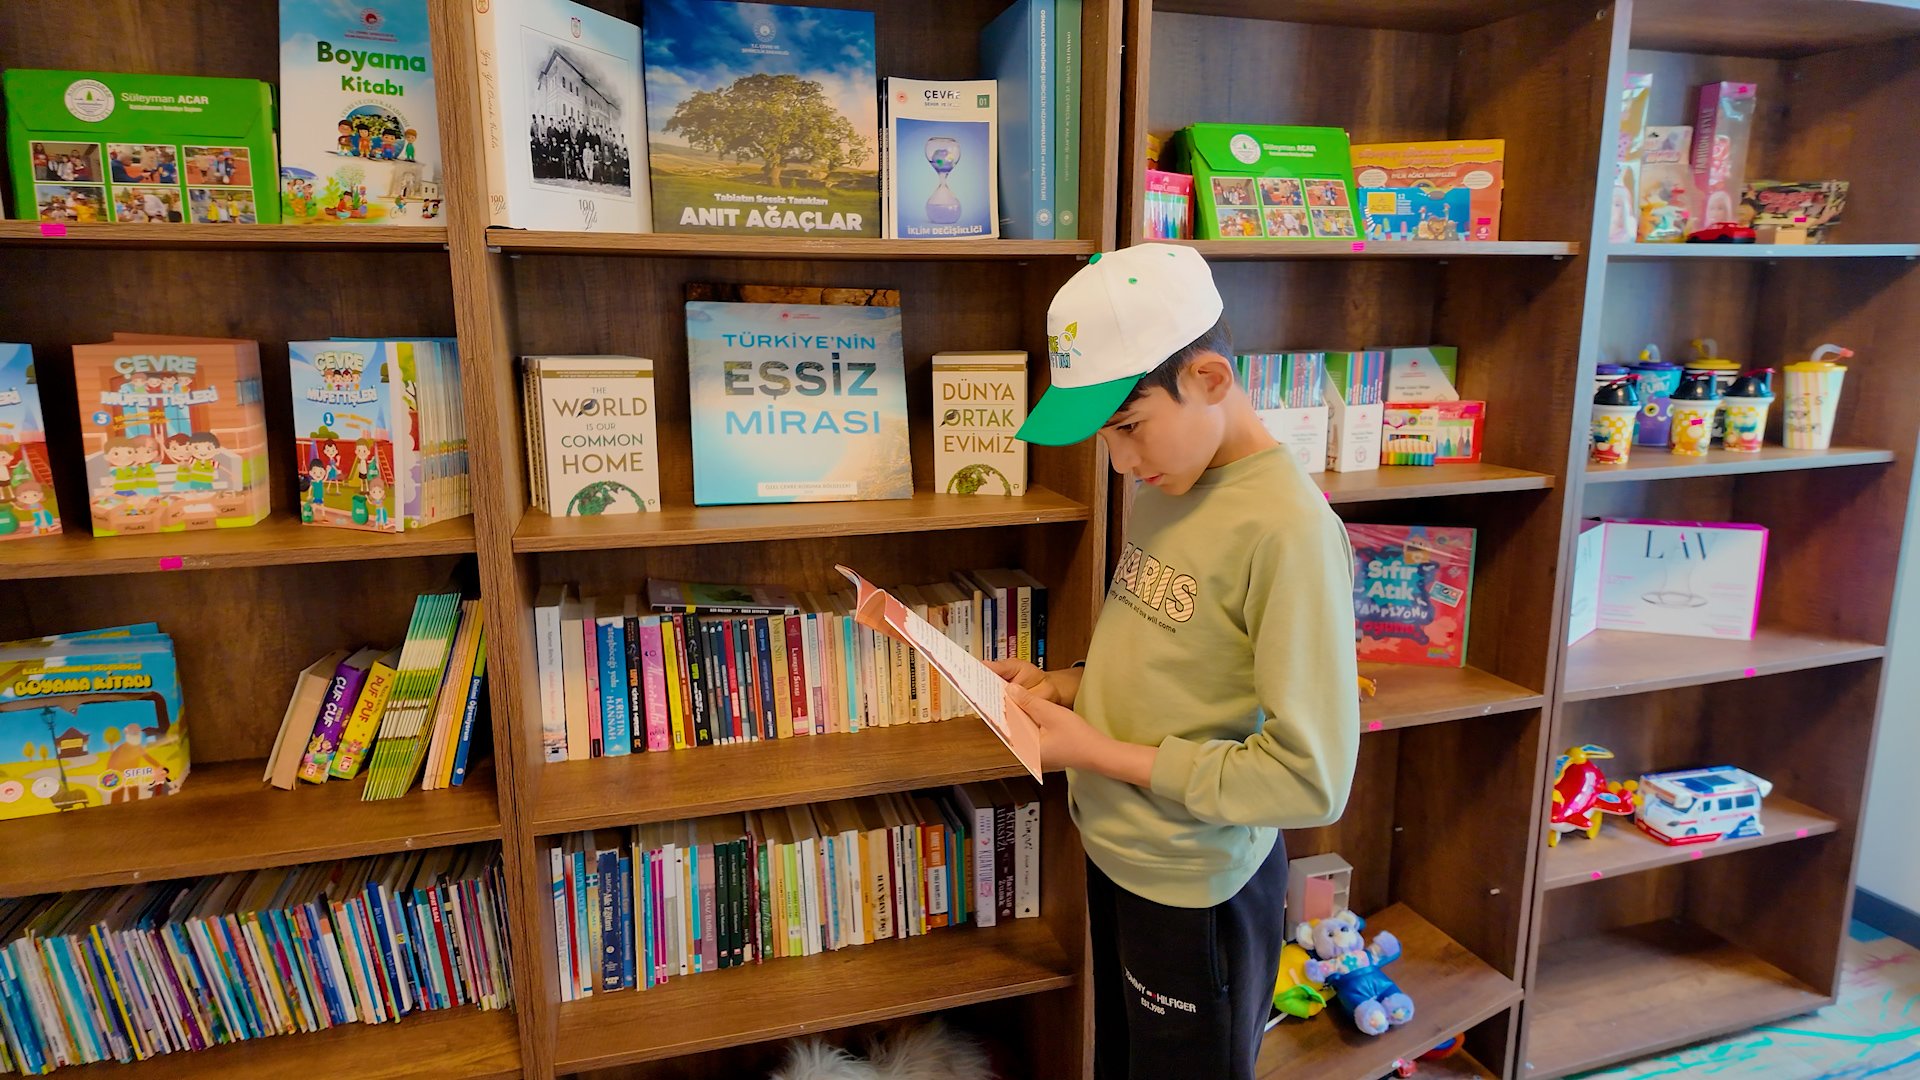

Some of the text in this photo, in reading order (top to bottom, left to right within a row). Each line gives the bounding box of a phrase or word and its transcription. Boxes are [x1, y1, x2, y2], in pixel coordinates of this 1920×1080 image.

[317, 41, 426, 72] Boyama
[341, 75, 404, 96] Kitabı
[121, 92, 209, 105] Süleyman ACAR
[979, 97, 987, 106] 01
[680, 205, 863, 232] ANIT AĞAÇLAR
[907, 225, 931, 235] İKLİM
[722, 331, 876, 350] TÜRKİYE'NİN
[114, 354, 197, 379] ÇEVRE
[723, 352, 878, 400] EŞSİZ
[943, 378, 1015, 401] DÜNYA
[552, 397, 648, 418] WORLD
[943, 409, 1015, 427] ORTAK
[97, 413, 107, 425] 3
[586, 423, 616, 431] IS OUR
[725, 404, 880, 435] MİRASI
[561, 434, 643, 448] COMMON
[944, 433, 1015, 453] EVİMİZ
[562, 452, 644, 475] HOME
[1645, 530, 1719, 560] LAV
[1368, 560, 1419, 580] Sıfır
[1366, 581, 1415, 601] Atık
[1158, 621, 1176, 634] come
[332, 676, 347, 702] ÇUF
[368, 675, 385, 699] PUF
[323, 702, 338, 727] ÇUF
[359, 700, 374, 723] PUF
[606, 695, 616, 740] HANNAH
[615, 698, 625, 736] KRISTIN
[125, 768, 153, 778] SIFIR
[979, 849, 993, 882] KUANTUM
[428, 890, 440, 923] RIFAT ILGAZ
[1156, 993, 1197, 1013] HILFIGER
